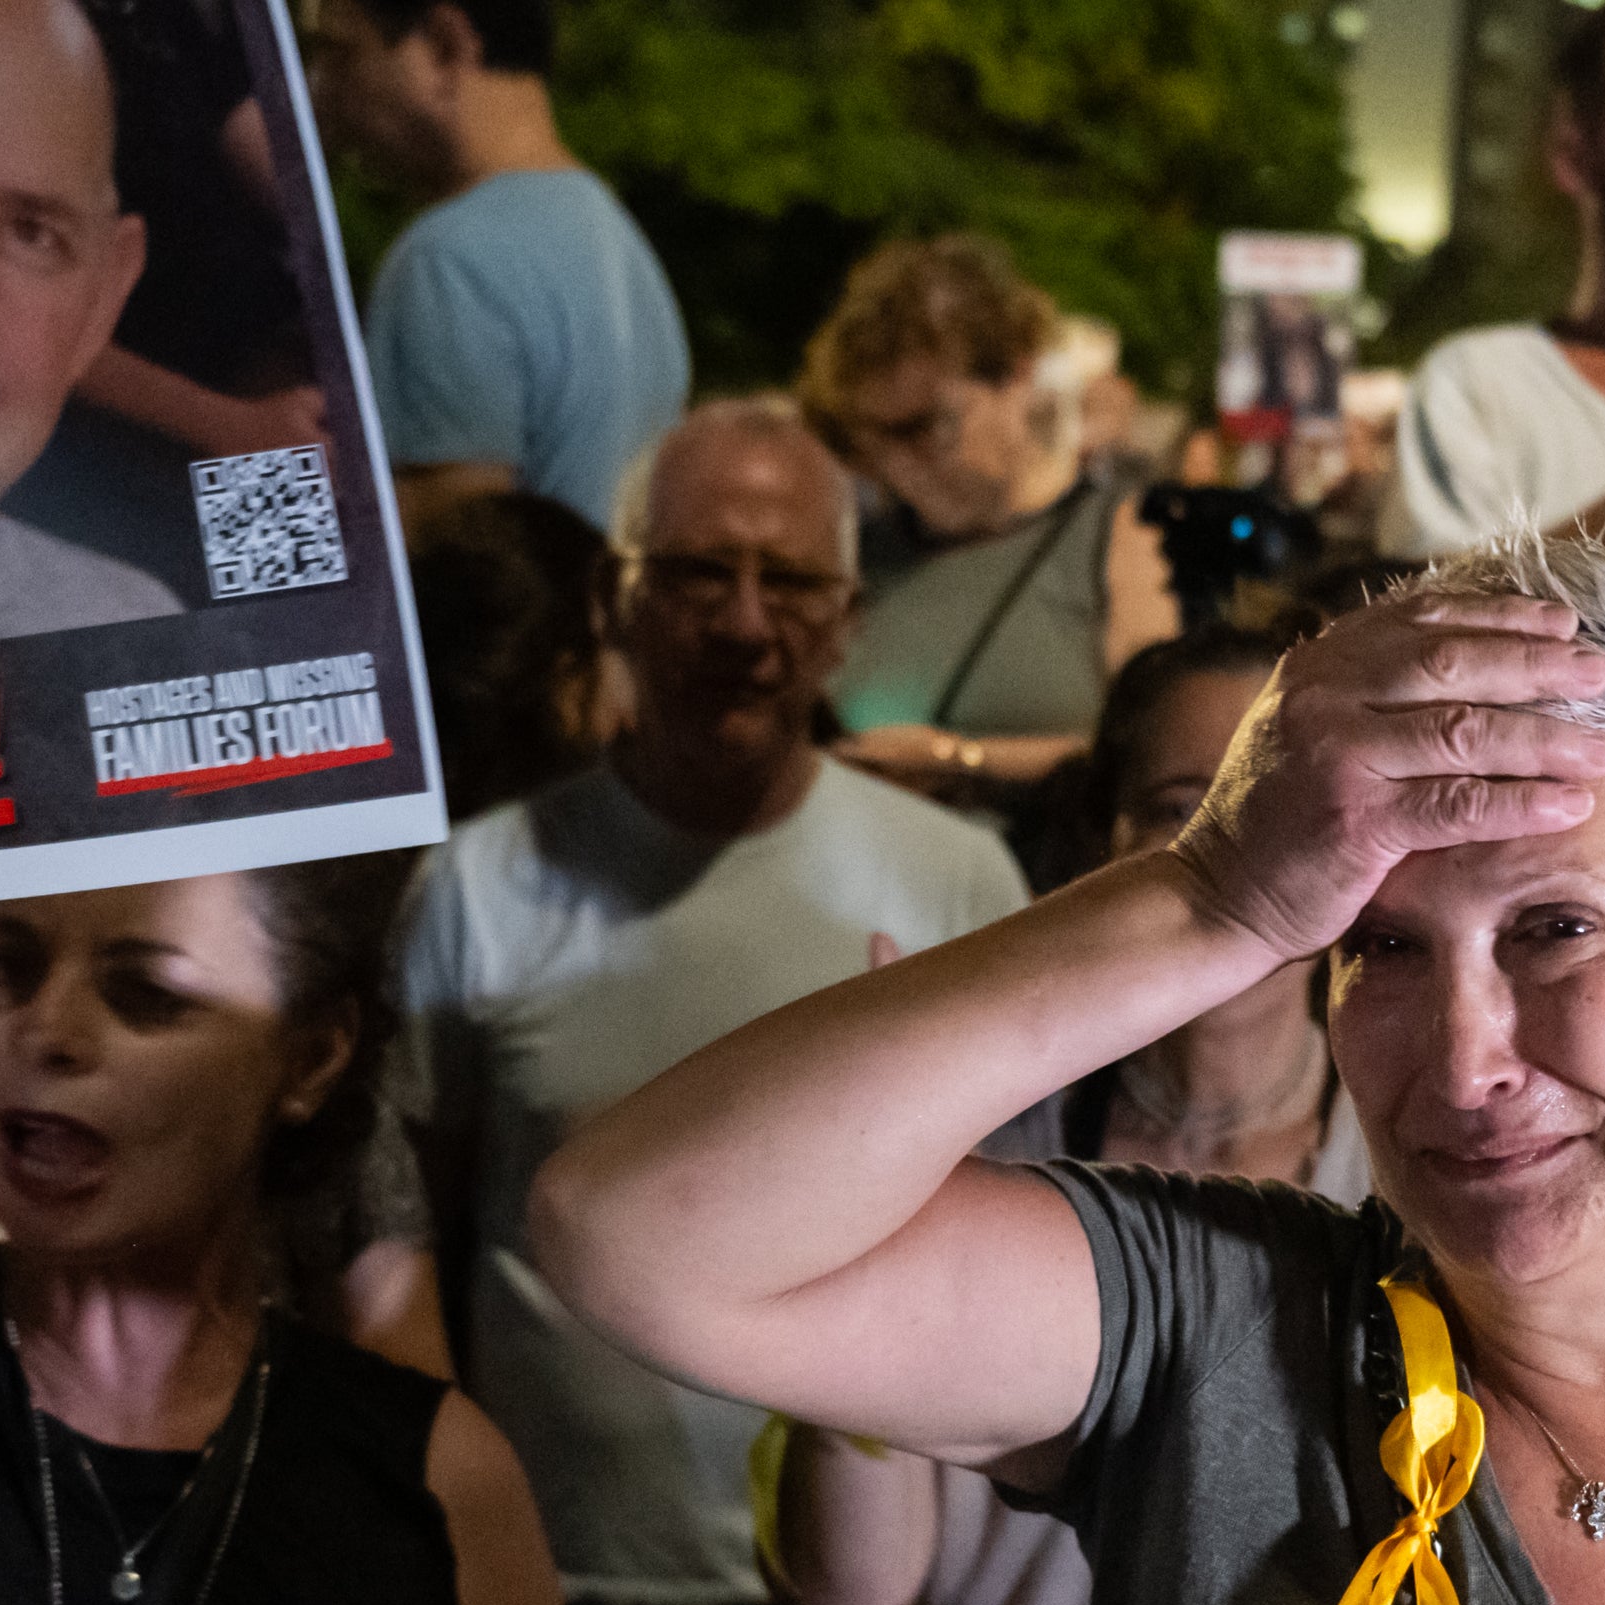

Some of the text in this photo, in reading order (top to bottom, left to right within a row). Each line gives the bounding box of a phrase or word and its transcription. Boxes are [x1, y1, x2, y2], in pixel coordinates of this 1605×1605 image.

[84, 651, 378, 728] HOSTAGES AND MISSING
[91, 690, 386, 784] FAMILIES FORUM
